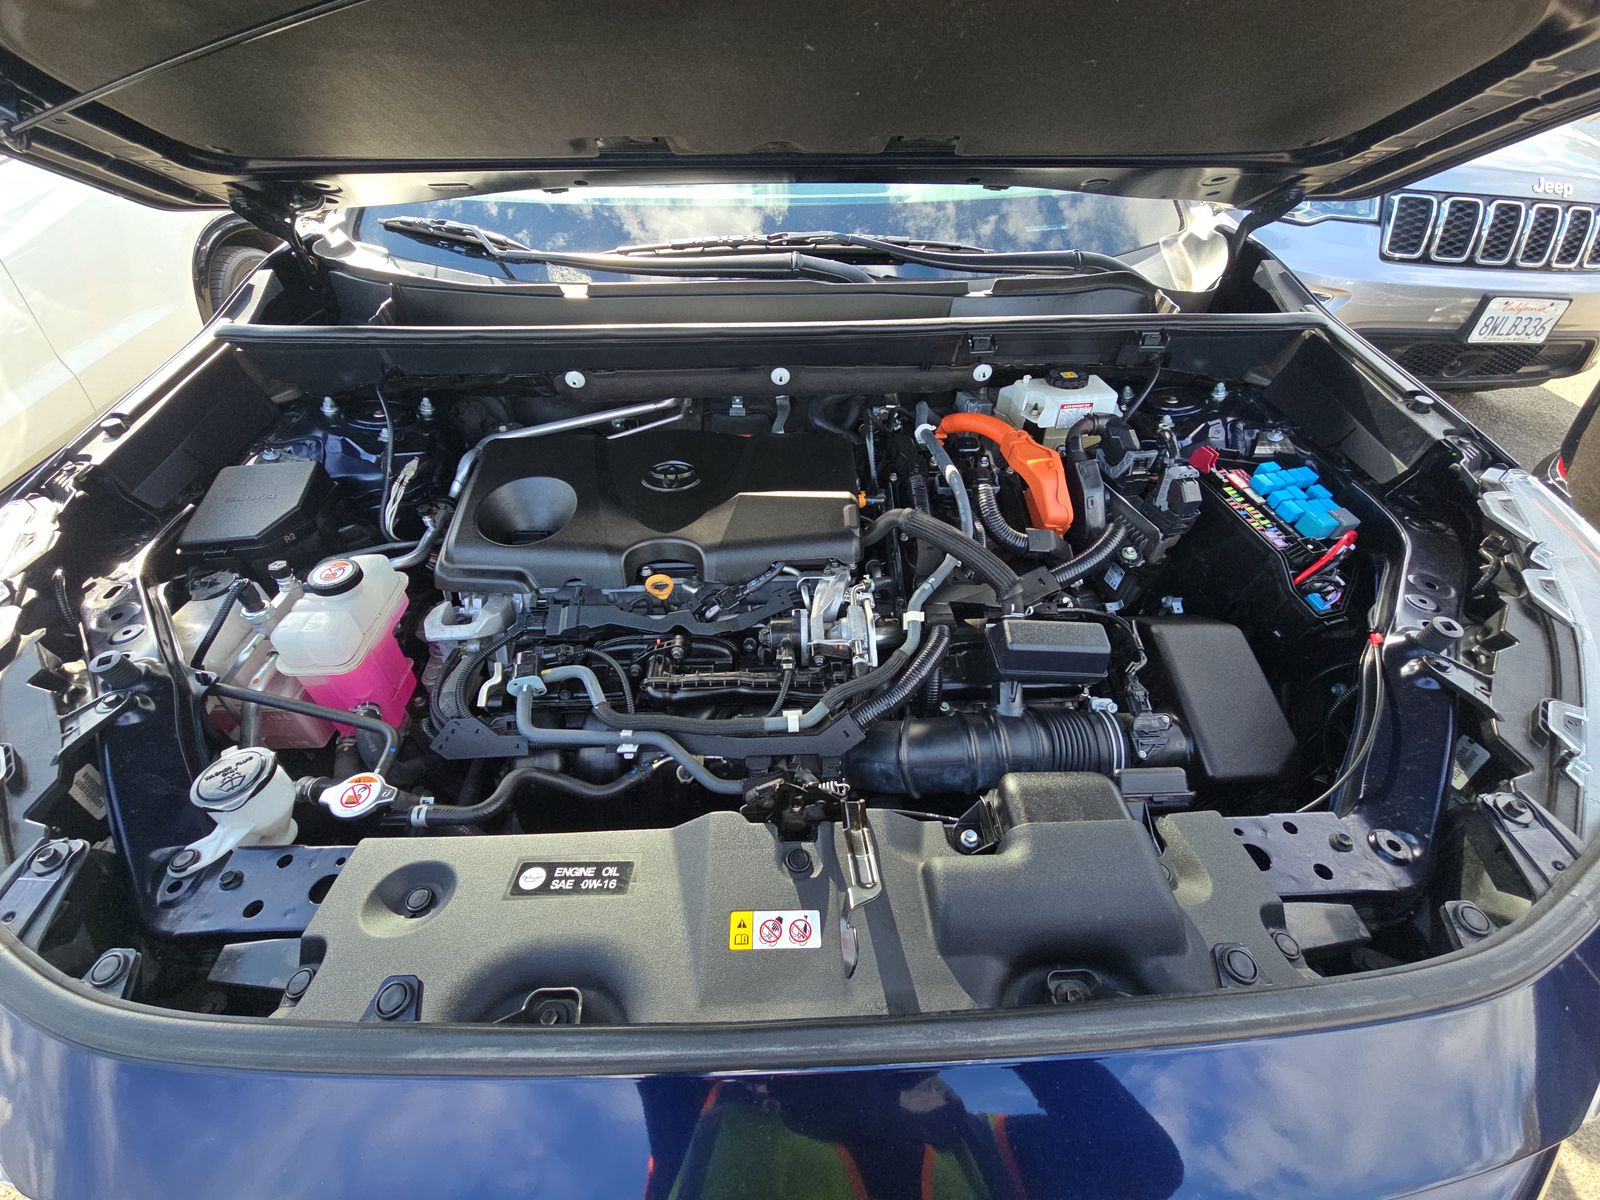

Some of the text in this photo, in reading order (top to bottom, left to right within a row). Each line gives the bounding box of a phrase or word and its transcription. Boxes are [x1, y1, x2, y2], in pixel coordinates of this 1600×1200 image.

[1532, 176, 1574, 198] Jeep
[1502, 301, 1548, 315] California
[1478, 315, 1554, 337] 8WLB336
[283, 532, 297, 544] R2
[554, 866, 620, 877] ENGINE OIL
[550, 879, 575, 890] SAE
